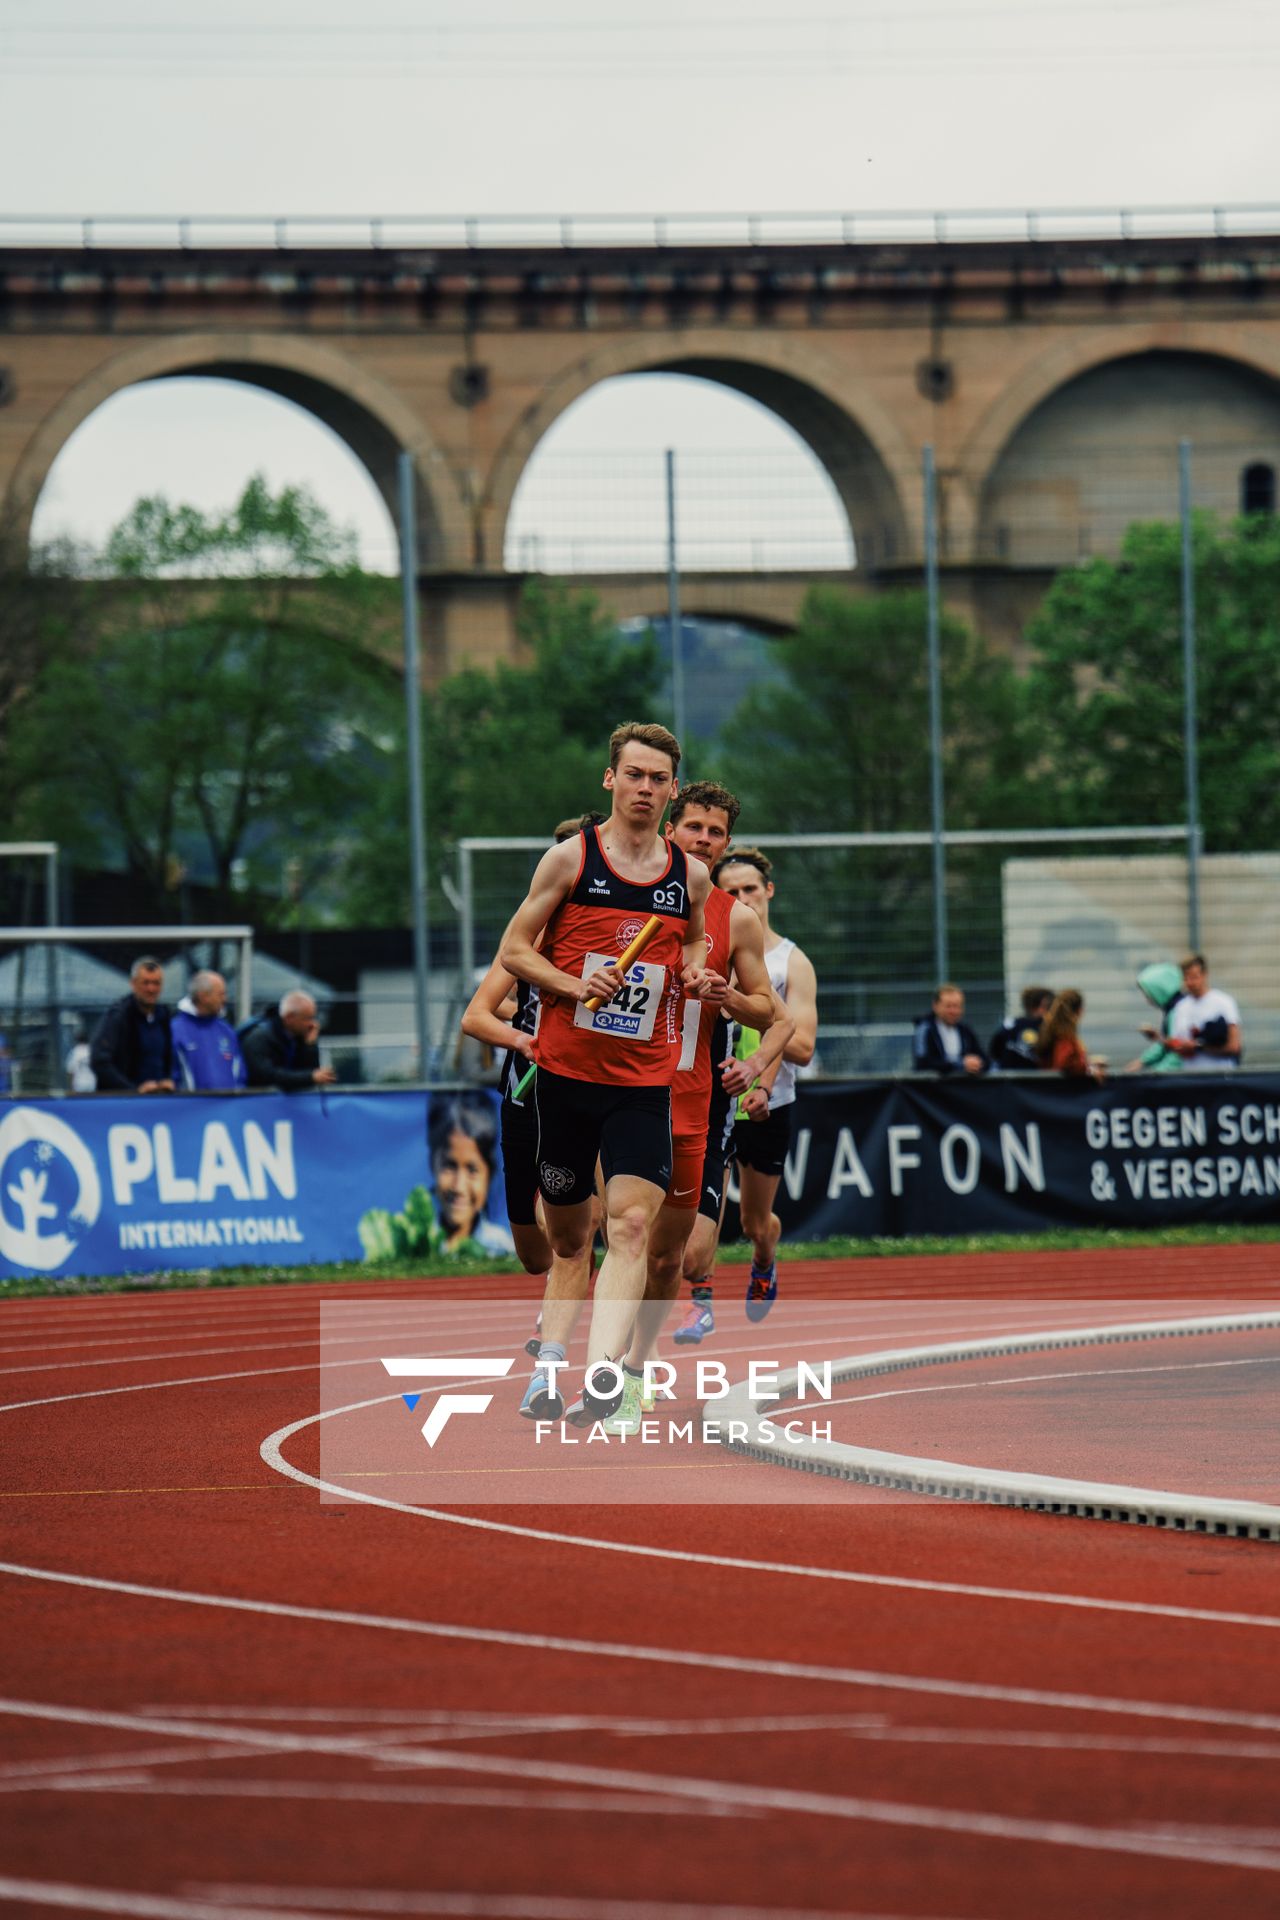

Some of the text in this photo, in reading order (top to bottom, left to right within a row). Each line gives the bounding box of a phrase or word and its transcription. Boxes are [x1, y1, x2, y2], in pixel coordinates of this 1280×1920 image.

[588, 887, 611, 895] erima
[653, 889, 676, 906] OS
[601, 984, 650, 1016] 42
[613, 1017, 639, 1029] PLAN
[1085, 1105, 1207, 1149] GEGEN
[107, 1120, 298, 1206] PLAN
[1090, 1160, 1117, 1201] &
[119, 1215, 304, 1250] INTERNATIONAL
